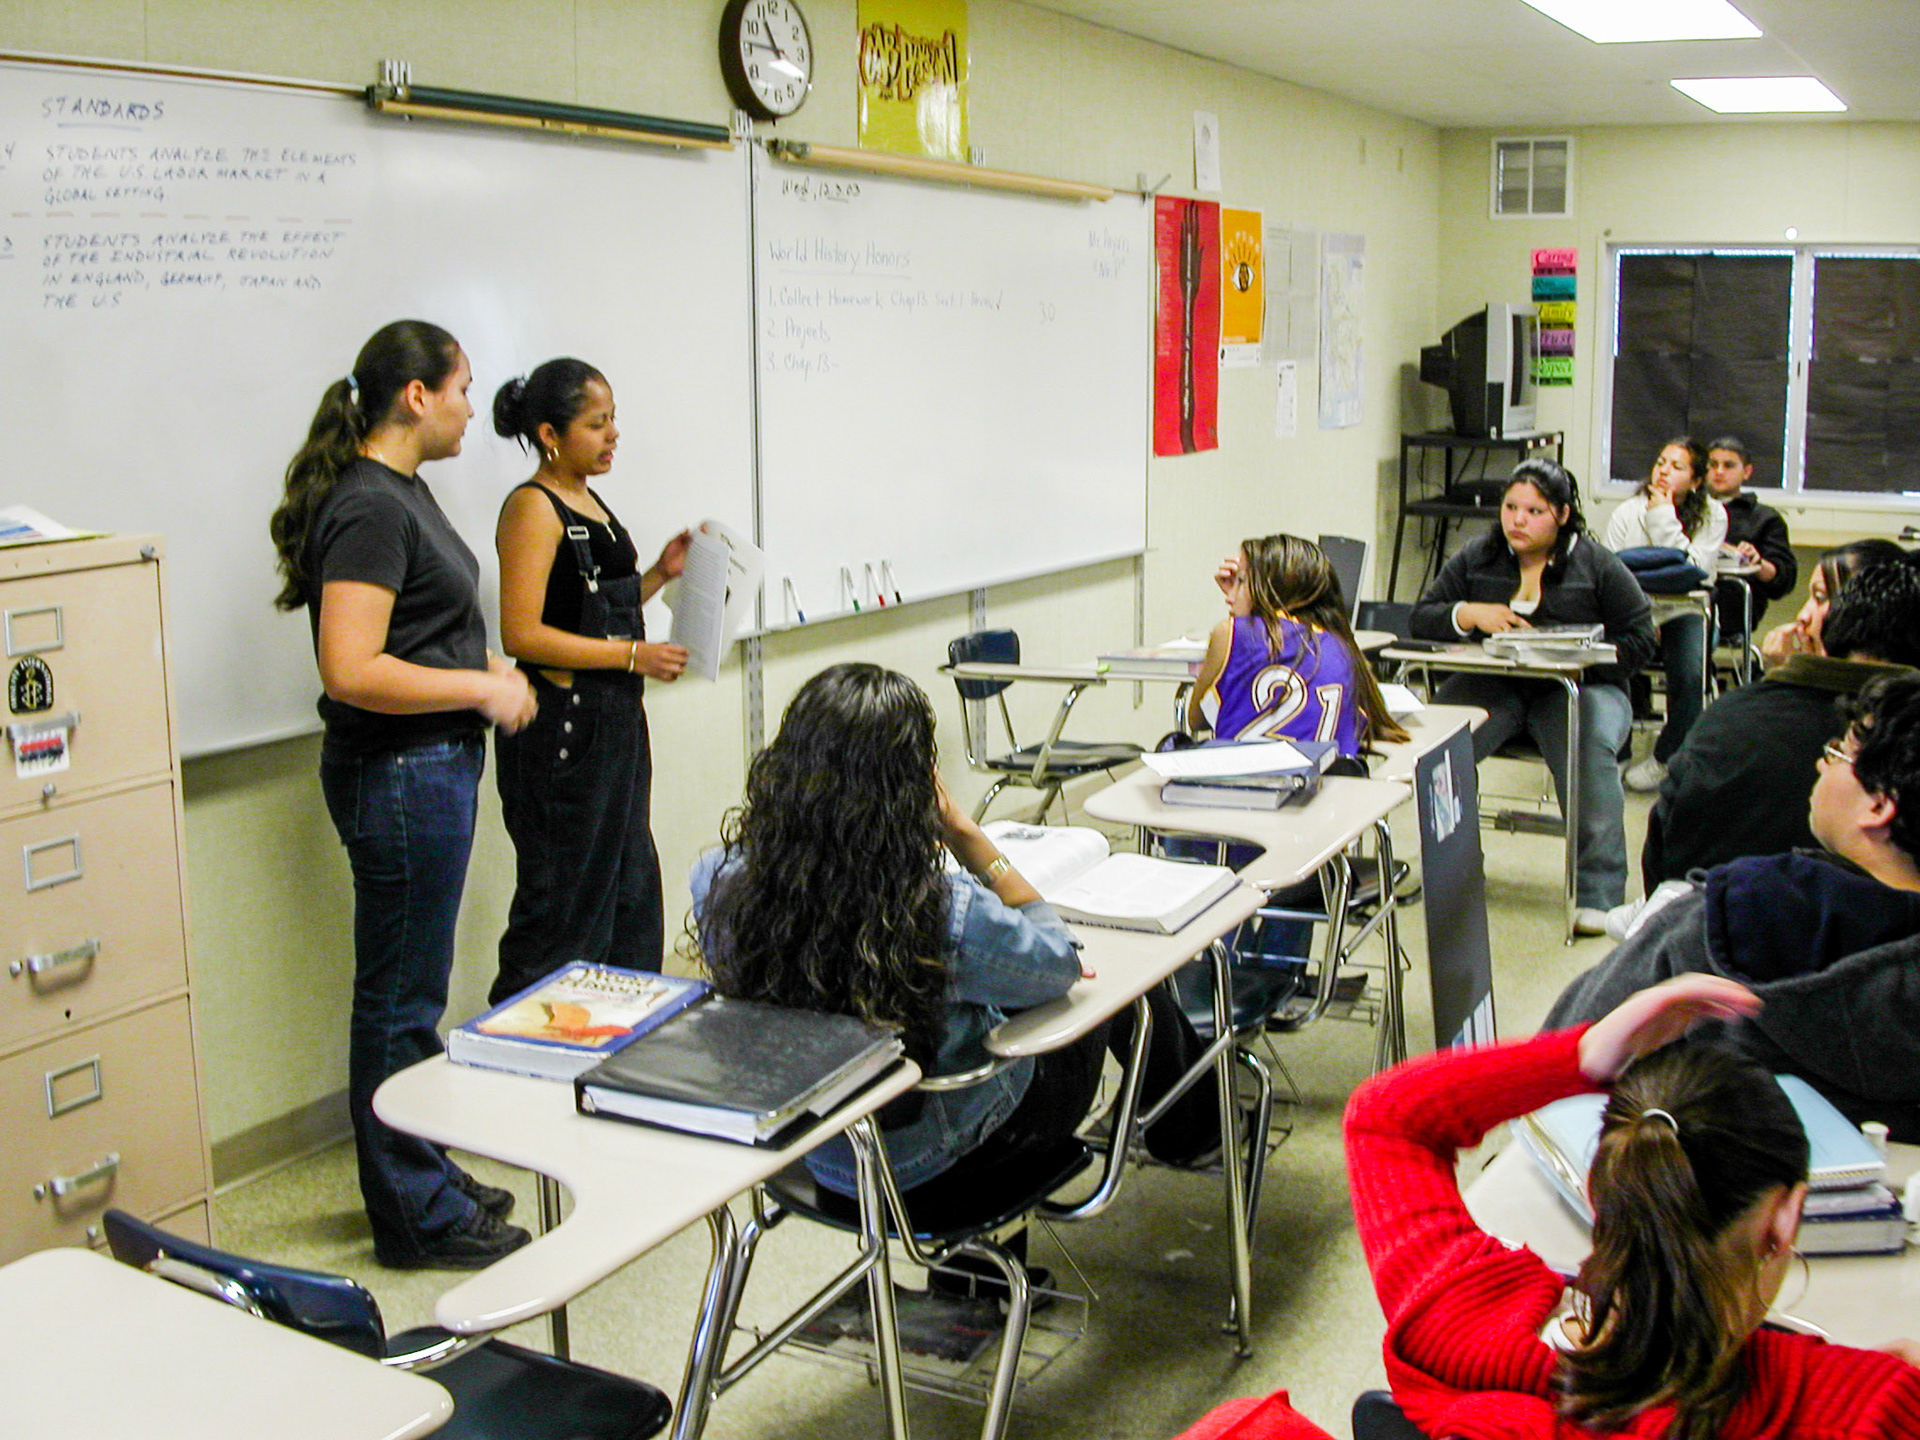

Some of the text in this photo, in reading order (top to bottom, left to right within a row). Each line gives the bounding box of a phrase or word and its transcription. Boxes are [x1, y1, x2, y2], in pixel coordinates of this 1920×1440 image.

[757, 4, 766, 20] 11
[767, 0, 778, 15] 12
[746, 20, 759, 35] 10
[792, 25, 800, 41] 2
[797, 47, 805, 63] 3
[749, 64, 759, 79] 8
[774, 89, 783, 104] 6
[786, 84, 795, 99] 5
[41, 98, 165, 121] STANDARDS
[45, 144, 139, 162] STUDENTS
[280, 147, 358, 166] ELEMENTS
[42, 164, 64, 183] OF
[73, 163, 108, 179] THE
[152, 166, 209, 182] LABOR
[216, 167, 289, 182] MARKET
[44, 185, 97, 204] GLOBAL
[43, 232, 141, 250] STUDENTS
[240, 230, 269, 244] THE
[282, 230, 347, 245] EFFECT
[42, 247, 336, 268] OF THE INDUSTRIAL REVOLUTION
[768, 236, 912, 275] World History Honors
[42, 272, 64, 287] IN
[239, 274, 288, 289] JAPAN
[293, 273, 322, 290] AND
[42, 293, 78, 310] THE
[780, 286, 823, 308] Collect
[828, 287, 884, 310] Homework
[785, 315, 831, 350] Projects
[1234, 664, 1344, 742] 21
